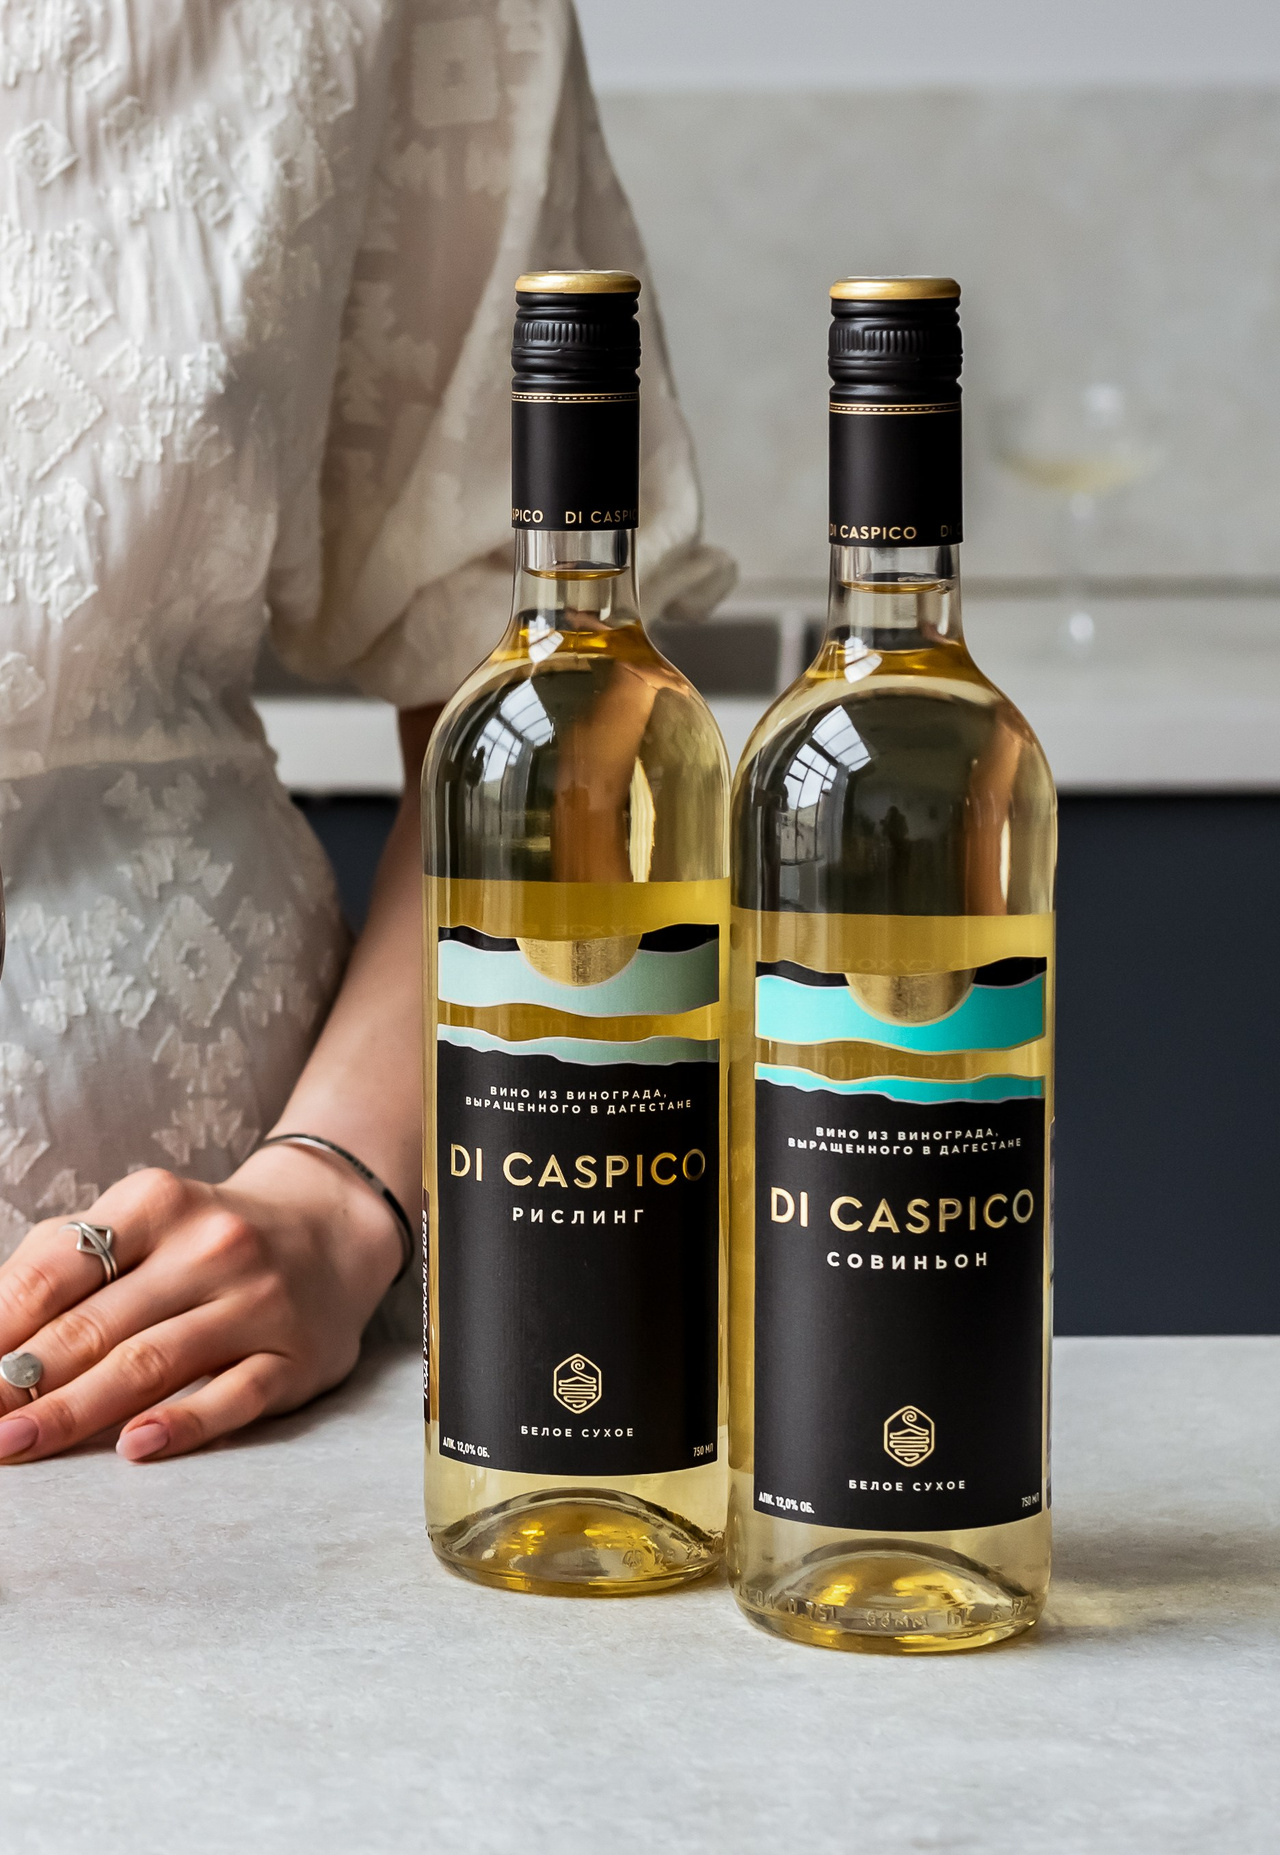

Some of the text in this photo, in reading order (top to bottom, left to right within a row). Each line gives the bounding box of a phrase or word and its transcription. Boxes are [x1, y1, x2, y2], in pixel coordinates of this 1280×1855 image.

[565, 511, 583, 524] DI
[840, 525, 918, 540] CASPICO
[490, 1086, 668, 1101] ВИНО ИЗ ВИНОГРАДА,
[465, 1096, 692, 1115] ВЫРАЩЕННОГО В ДАГЕСТАНЕ
[815, 1126, 999, 1141] ВИНО ИЗ ВИНОГРАДА,
[787, 1137, 1021, 1156] ВЫРАЩЕННОГО В ДАГЕСТАНЕ
[450, 1143, 706, 1189] DI CASPICO
[512, 1207, 644, 1225] РИСЛИНГ
[770, 1186, 1034, 1234] DI CASPICO
[826, 1251, 988, 1270] СОВИНЬОН
[520, 1425, 634, 1438] БЕЛОЕ СУХОЕ
[457, 1441, 476, 1455] 12,0%
[477, 1445, 490, 1458] ОБ.
[693, 1445, 704, 1457] 750
[848, 1479, 966, 1492] БЕЛОЕ СУХОЕ
[776, 1496, 799, 1511] 12,0%
[799, 1501, 815, 1514] ОБ.
